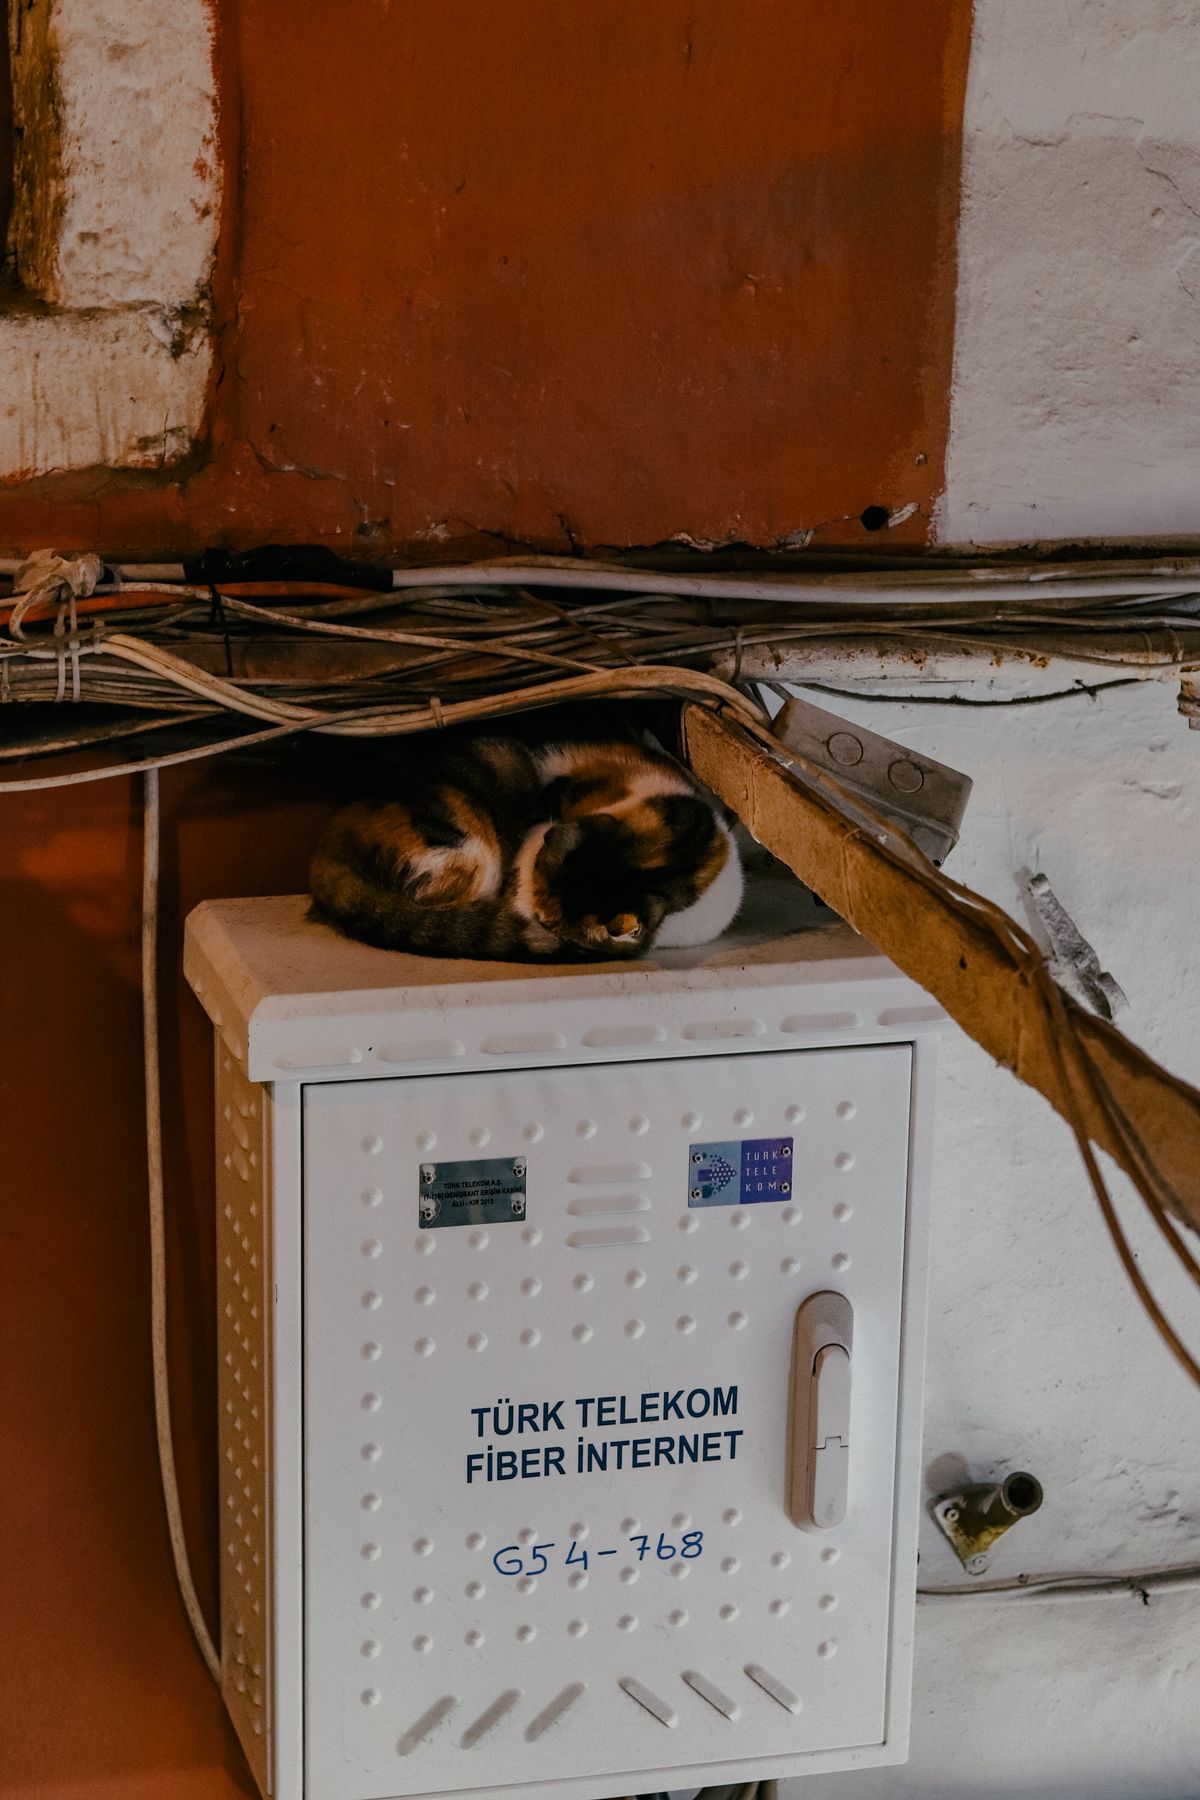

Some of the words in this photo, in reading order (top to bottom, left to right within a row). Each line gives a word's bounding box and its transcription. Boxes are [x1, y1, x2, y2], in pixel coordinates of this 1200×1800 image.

[745, 1165, 777, 1176] TELE
[461, 1180, 490, 1188] TELEKOM
[745, 1181, 777, 1192] KOM
[471, 1398, 565, 1437] TÜRK
[575, 1386, 738, 1428] TELEKOM
[466, 1445, 566, 1483] FİBER
[577, 1430, 744, 1473] İNTERNET
